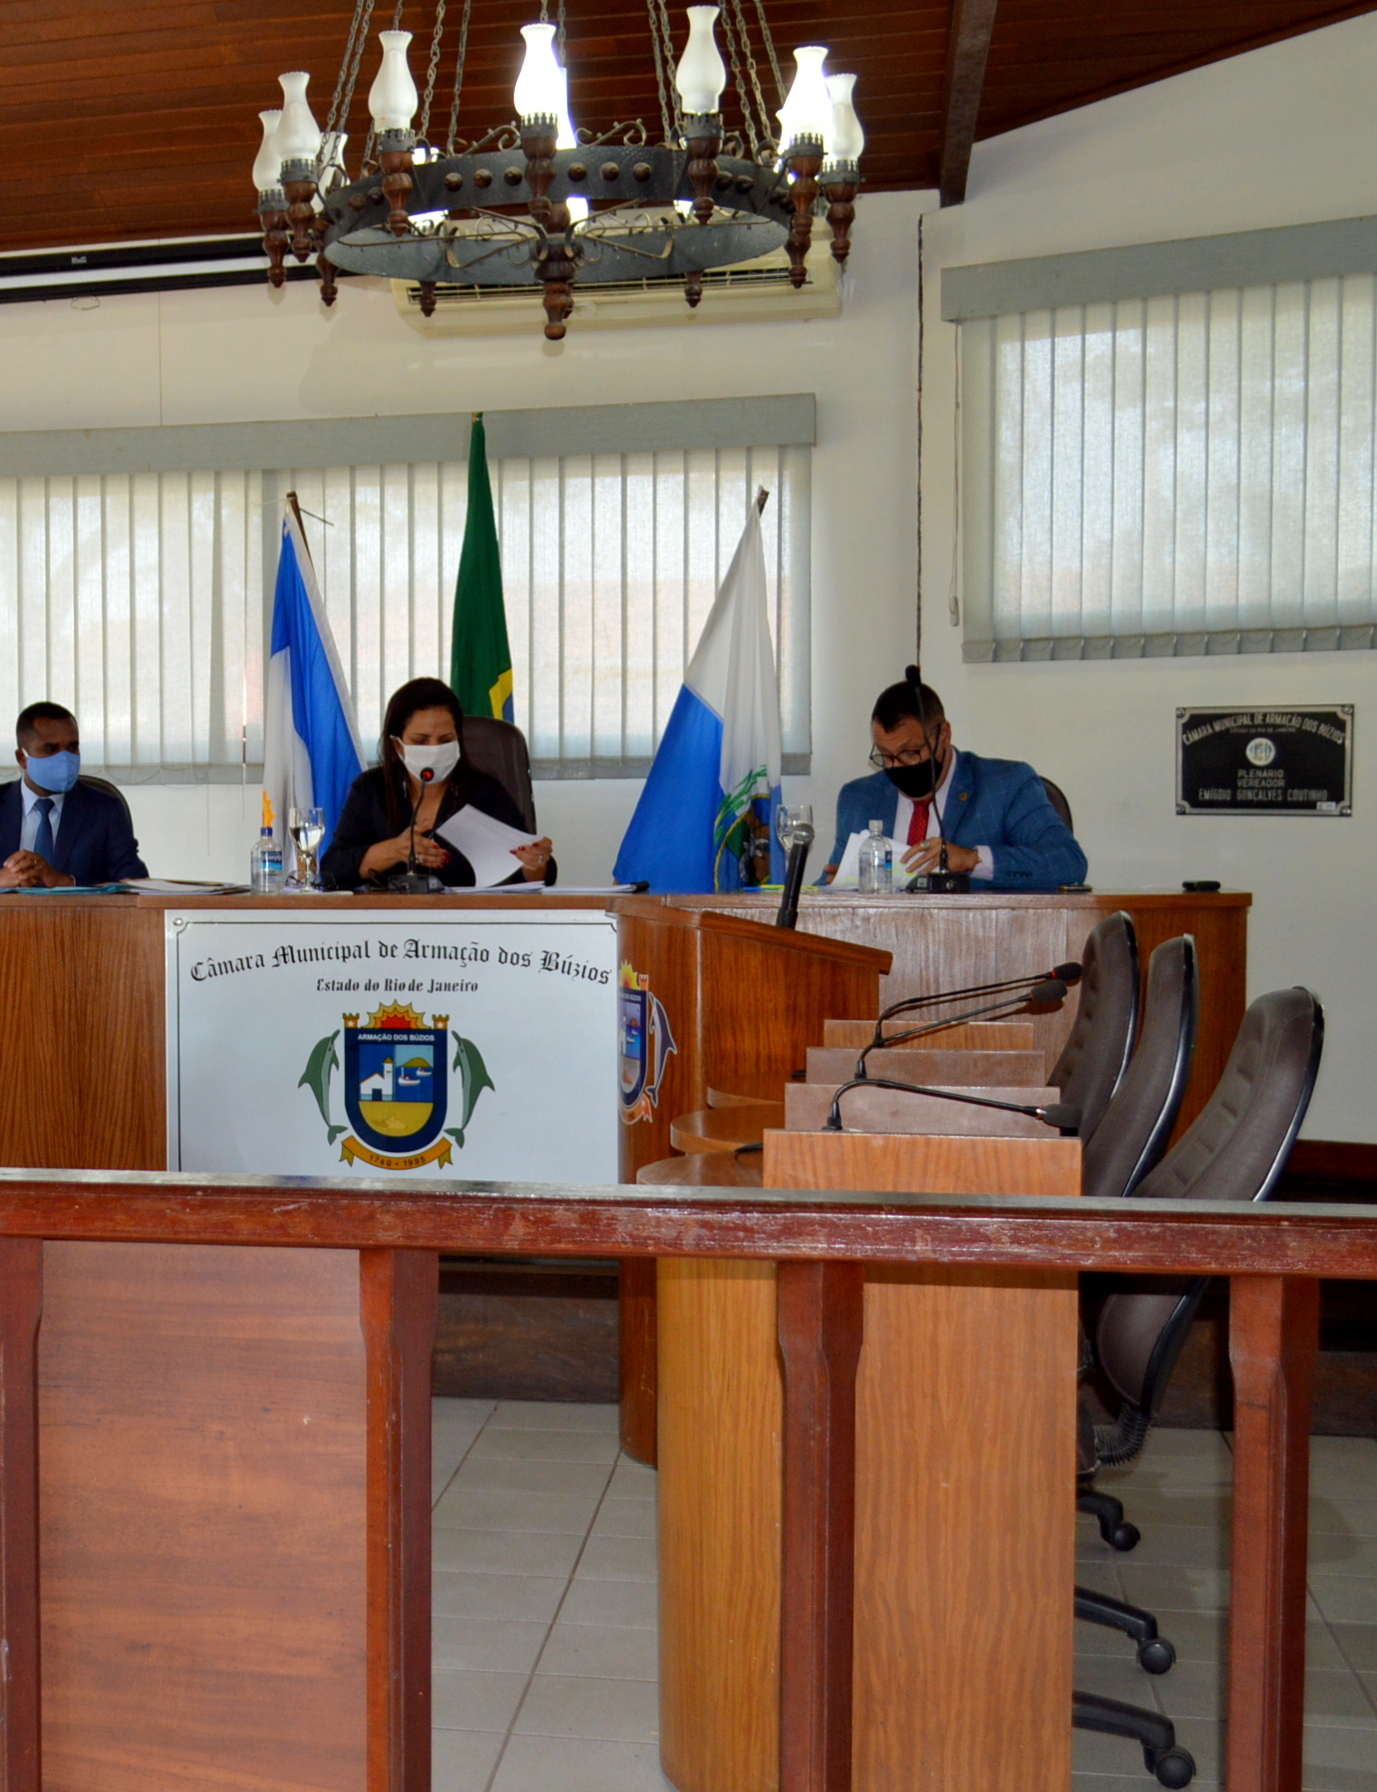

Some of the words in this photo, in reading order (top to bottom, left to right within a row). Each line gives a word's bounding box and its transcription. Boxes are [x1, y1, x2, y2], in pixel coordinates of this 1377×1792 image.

[1182, 722, 1213, 745] CÂMARA
[1213, 713, 1252, 732] MUNICIPAL
[1254, 712, 1265, 725] DE
[1265, 712, 1302, 729] ARMAÇÃO
[1302, 717, 1318, 734] DOS
[1237, 768, 1284, 778] PLENÁRIO
[1237, 779, 1285, 787] VEREADOR
[1236, 788, 1283, 802] GONÇALVES
[1287, 788, 1328, 801] COUTINHO
[190, 954, 266, 981] Câmara
[272, 940, 371, 968] Municipal
[378, 940, 398, 958] de
[403, 939, 490, 967] Armação
[498, 946, 532, 967] dos
[538, 949, 613, 985] Búzios
[316, 978, 360, 992] Estado
[364, 978, 380, 992] do
[384, 978, 406, 992] Rio
[408, 978, 424, 992] de
[427, 979, 478, 993] Janeiro
[357, 1033, 392, 1042] ARMAÇÃO
[409, 1033, 435, 1042] BÚZIOS
[369, 1155, 392, 1167] 1740
[403, 1155, 426, 1167] 1995
